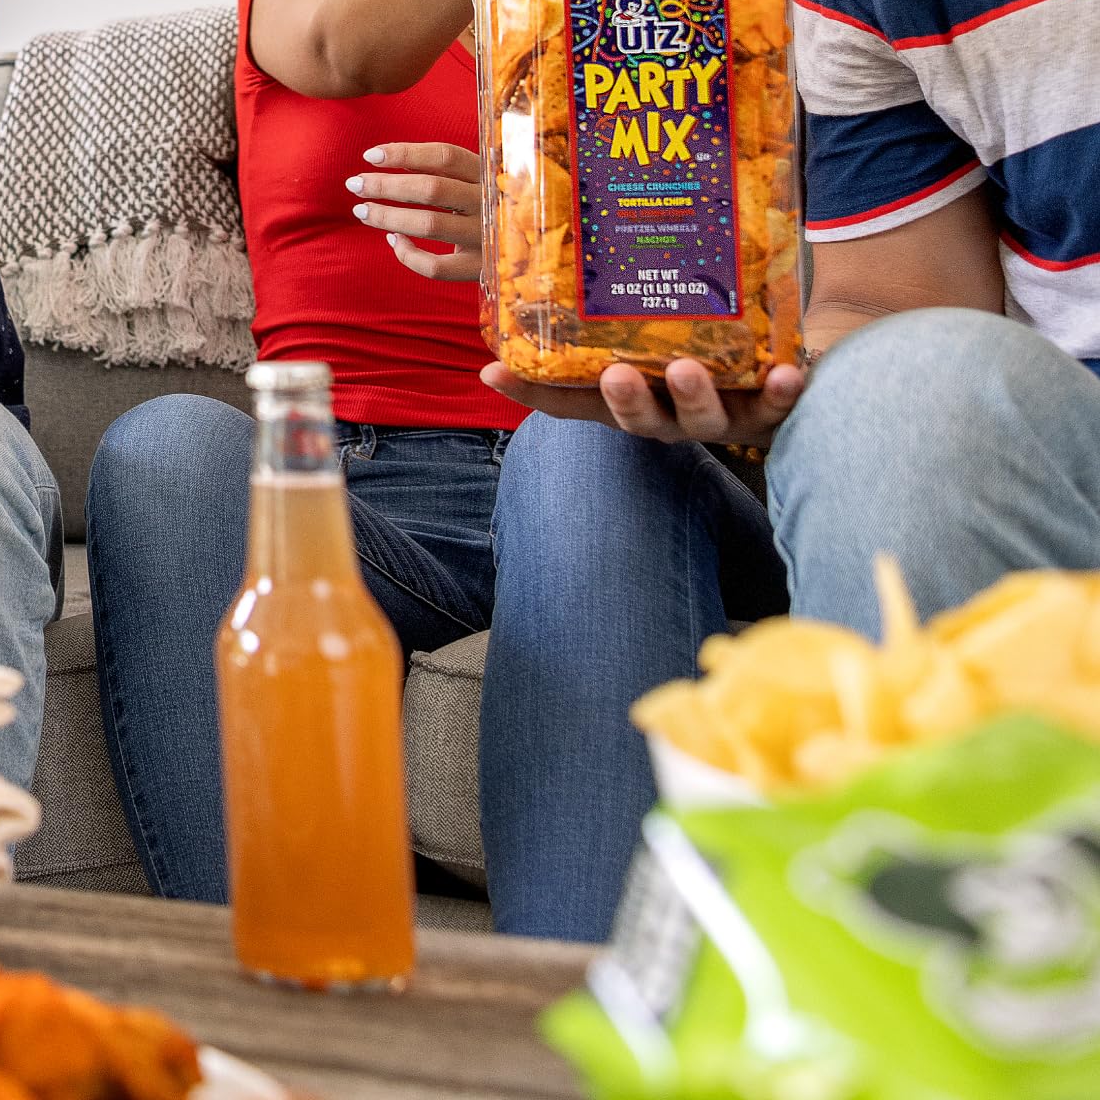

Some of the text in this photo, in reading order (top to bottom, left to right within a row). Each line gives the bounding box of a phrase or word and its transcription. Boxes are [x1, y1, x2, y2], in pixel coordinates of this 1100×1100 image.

[584, 56, 722, 114] PARTY
[610, 111, 697, 166] MIX
[607, 181, 701, 192] CHEESE CRUNCHIES
[618, 196, 694, 207] TORTILLA CHIPS
[615, 223, 697, 233] PRETZEL WHEELS
[636, 236, 677, 244] NACHOS
[638, 269, 679, 281] NET WT
[611, 282, 709, 296] 26 OZ (1 LB 10 OZ)
[641, 297, 679, 310] 737.1g
